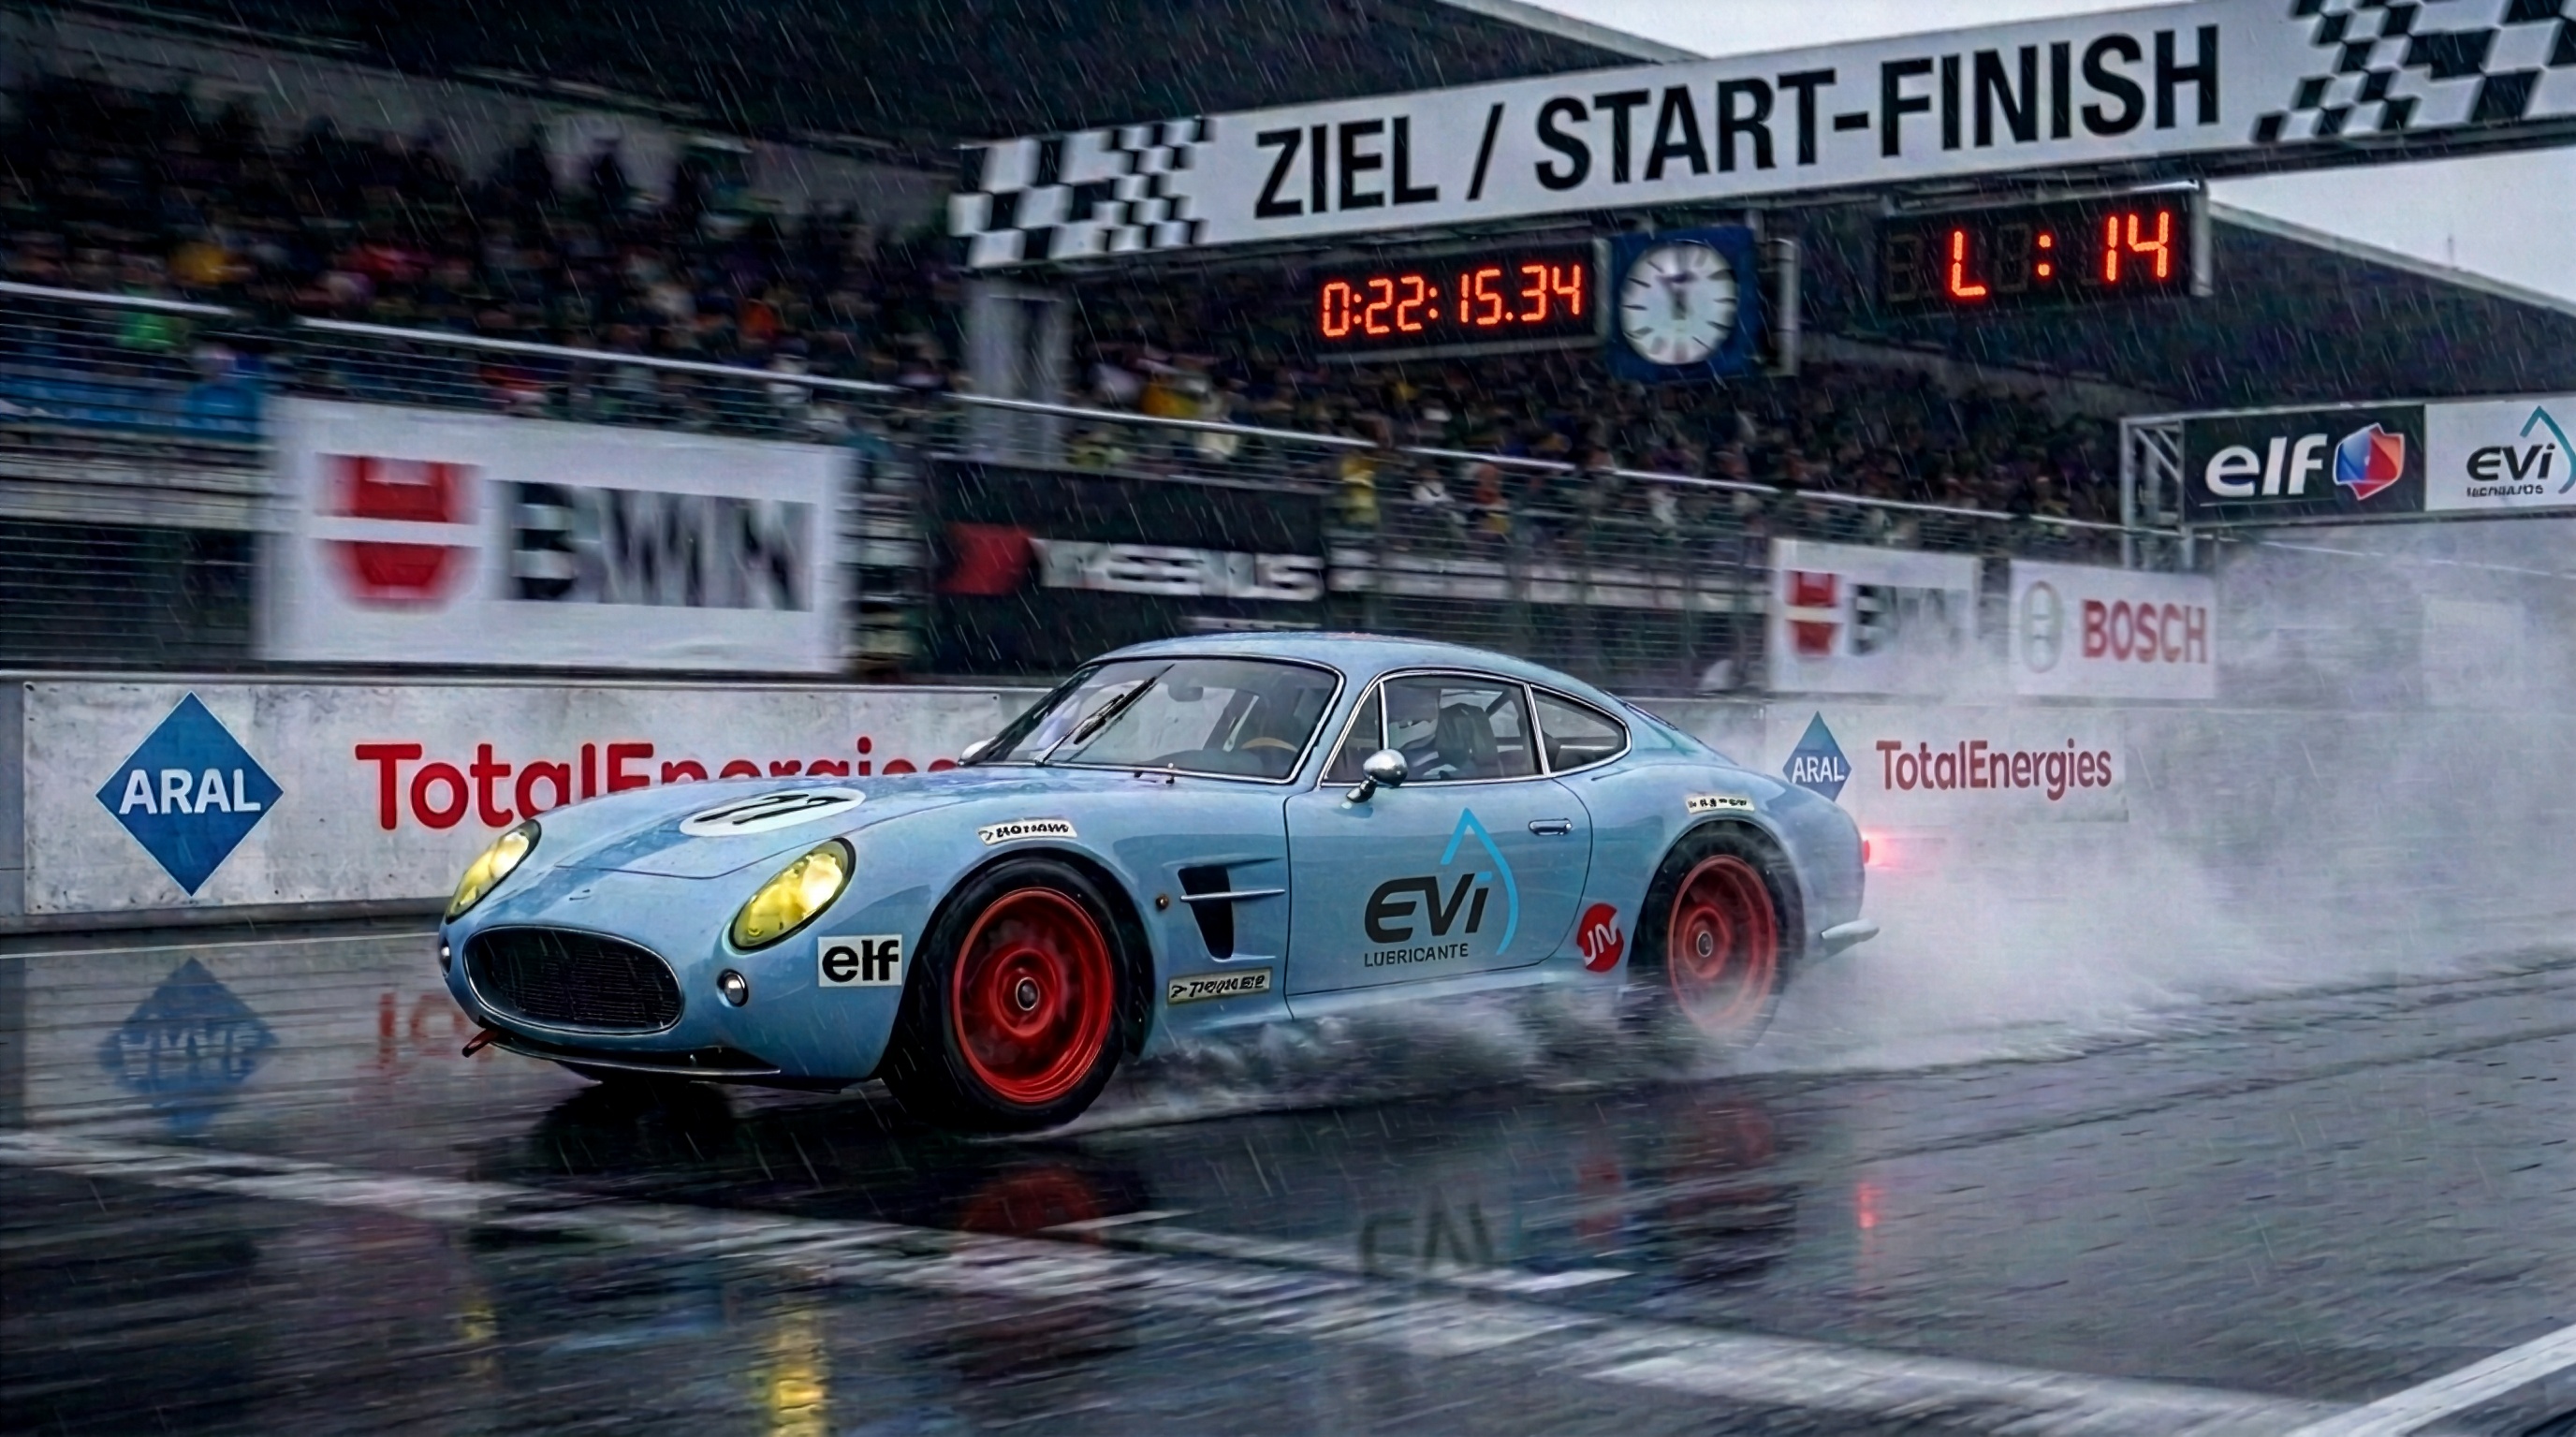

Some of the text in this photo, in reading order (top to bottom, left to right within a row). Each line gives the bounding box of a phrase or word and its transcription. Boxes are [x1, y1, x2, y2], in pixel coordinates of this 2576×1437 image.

[1254, 24, 2219, 220] ZIEL / START-FINISH
[1950, 230, 1987, 298] L
[2105, 211, 2170, 282] 14
[2205, 433, 2328, 497] elf
[2081, 599, 2208, 664] BOSCH
[119, 768, 262, 815] ARAL
[1792, 755, 1845, 784] ARAL
[1876, 739, 2113, 801] TotalEnergies
[821, 938, 900, 982] elf
[1364, 942, 1469, 968] LUBRICANTE
